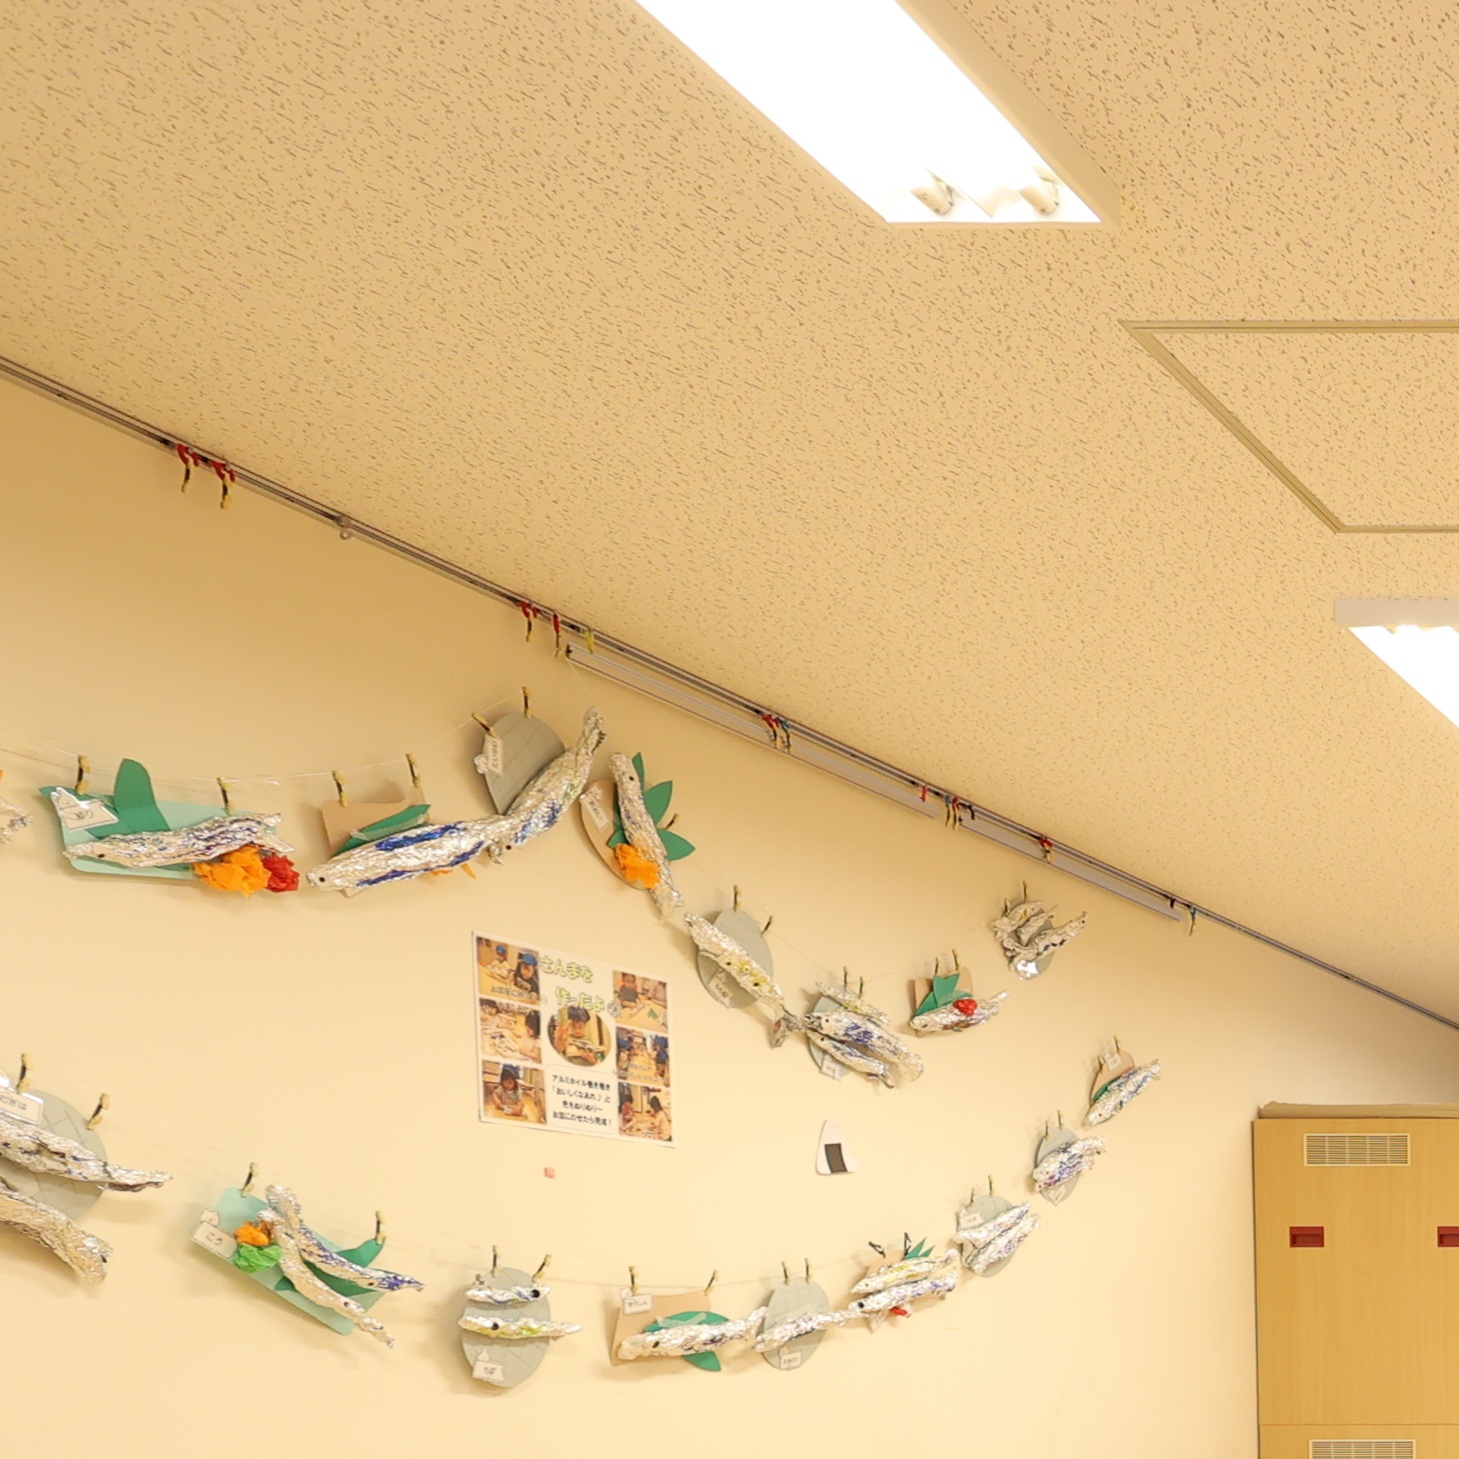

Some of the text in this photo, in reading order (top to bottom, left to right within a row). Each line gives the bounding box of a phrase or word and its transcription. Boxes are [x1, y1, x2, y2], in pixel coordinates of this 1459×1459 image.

[539, 955, 593, 983] さんまを
[555, 986, 605, 1013] 作ったよ
